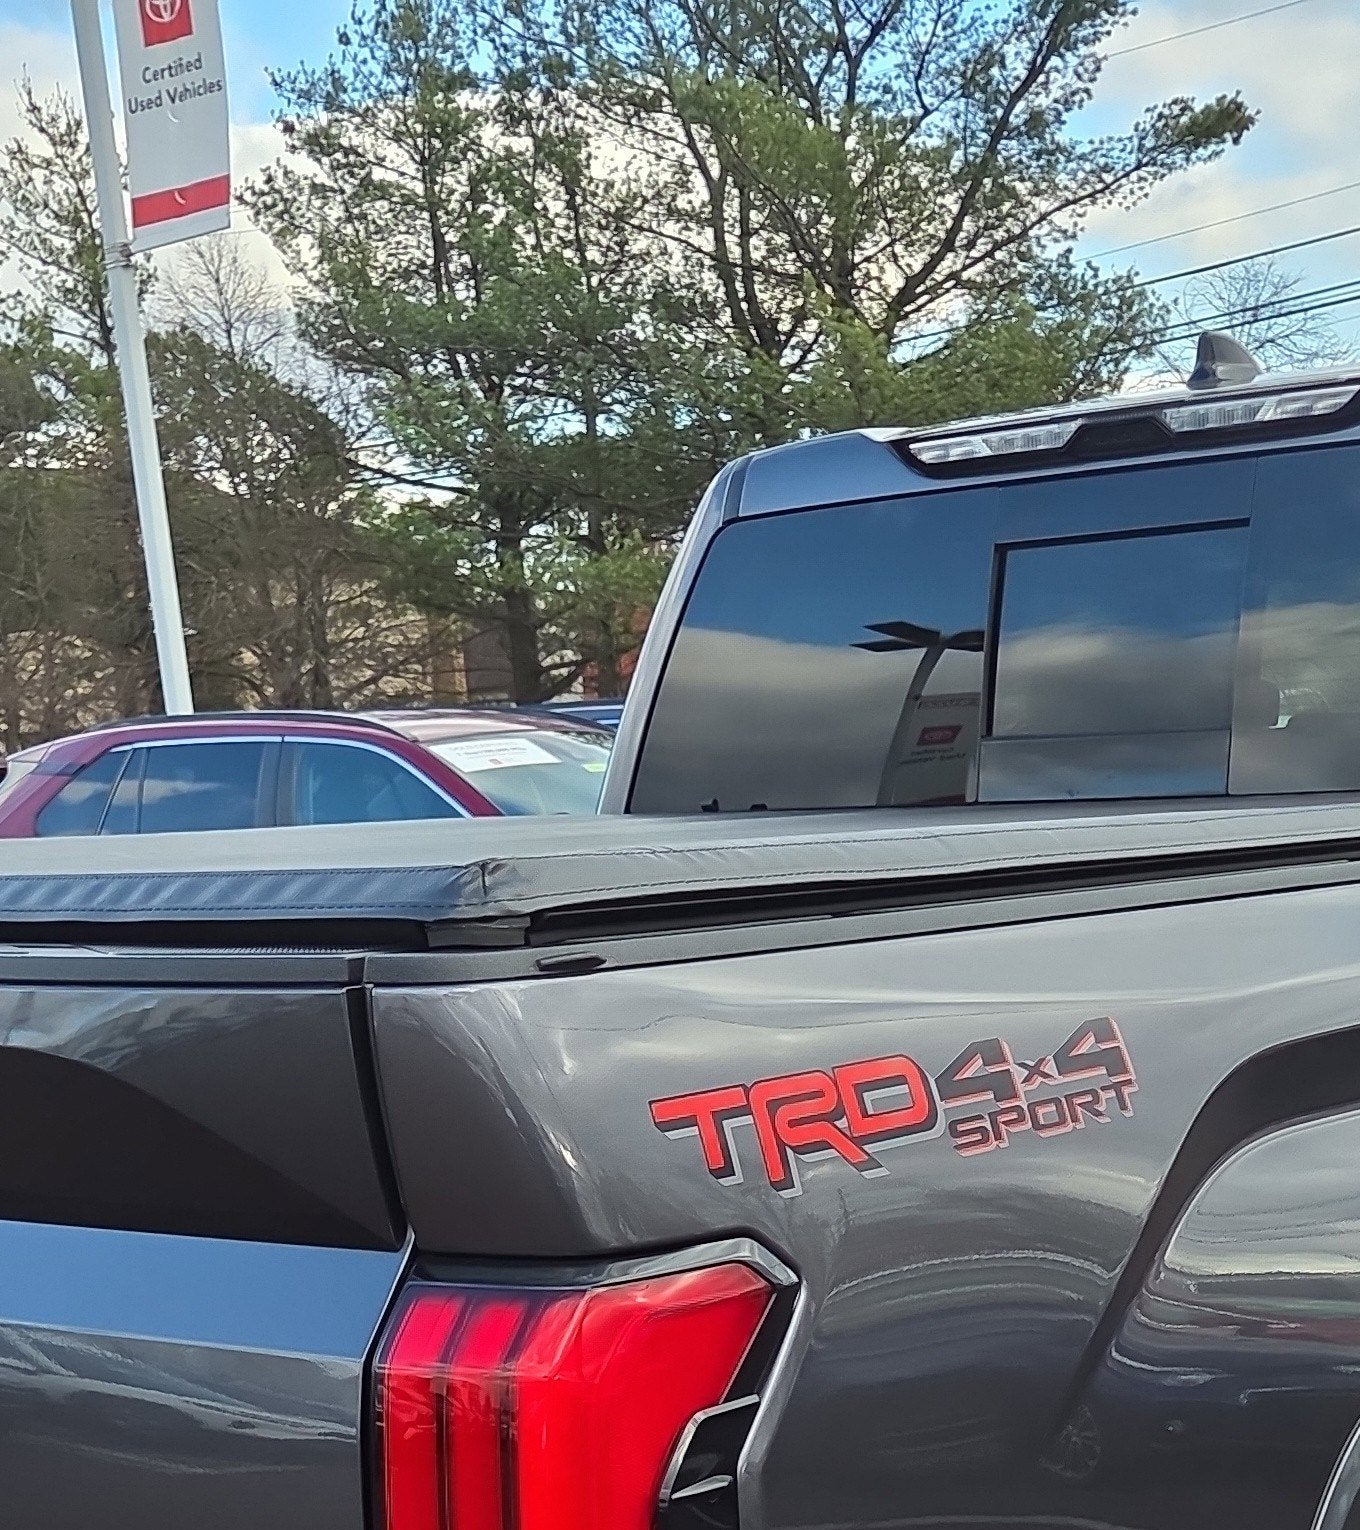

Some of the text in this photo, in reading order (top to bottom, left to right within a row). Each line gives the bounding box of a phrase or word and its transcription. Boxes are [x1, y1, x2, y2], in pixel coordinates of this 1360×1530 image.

[127, 78, 223, 115] Used Vehicles
[141, 52, 204, 84] Certified
[648, 1015, 1136, 1199] TRD 4x4
[947, 1077, 1139, 1158] SPORT
